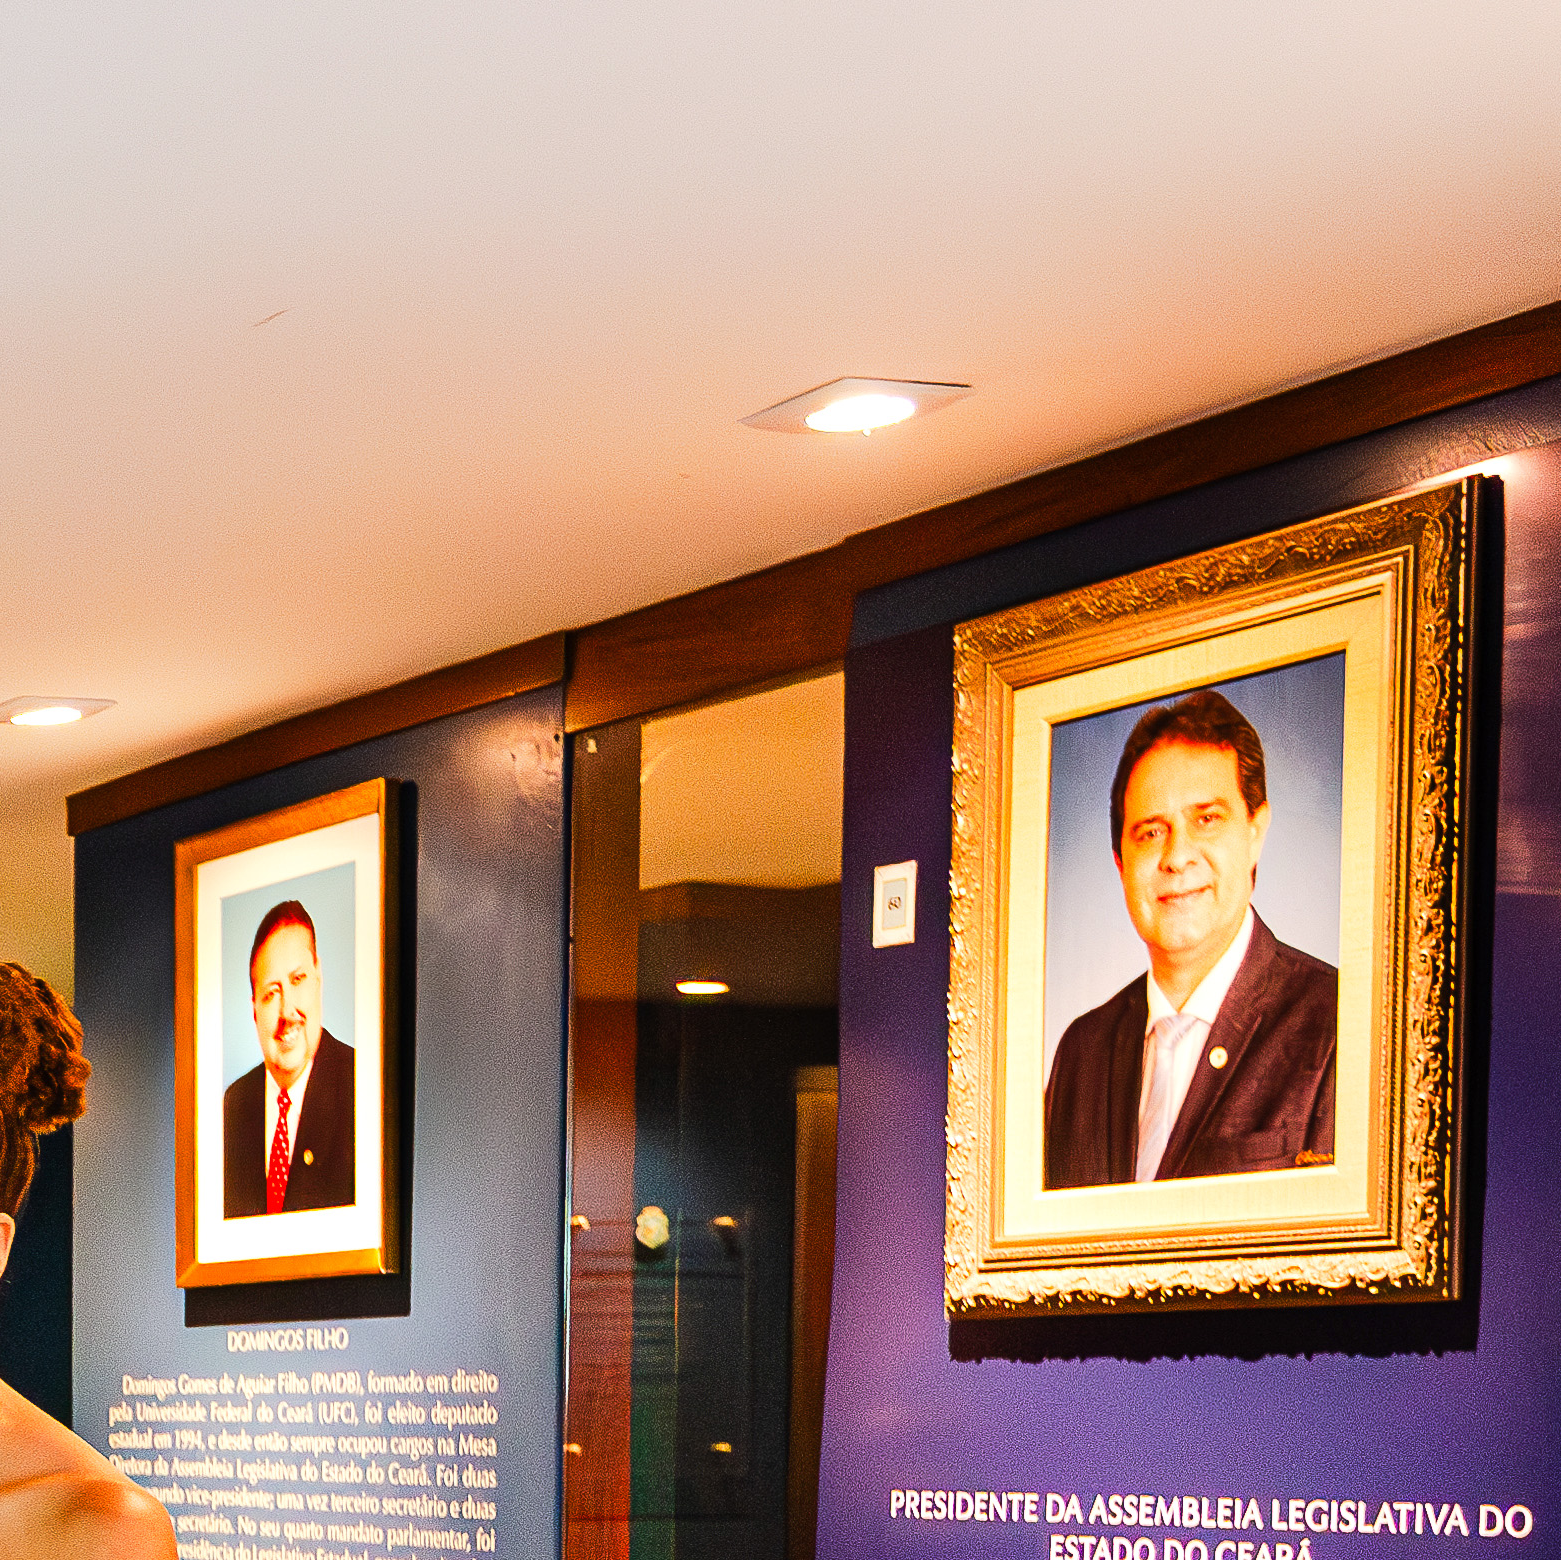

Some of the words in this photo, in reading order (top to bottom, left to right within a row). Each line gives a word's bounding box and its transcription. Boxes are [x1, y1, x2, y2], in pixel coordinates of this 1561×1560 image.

[228, 1329, 303, 1351] DOMINGOS
[306, 1327, 348, 1349] FILHO
[890, 1489, 1038, 1522] PRESIDENTE
[1045, 1492, 1083, 1523] DA
[1088, 1494, 1263, 1529] ASSEMBLEIA
[1271, 1499, 1468, 1536] LEGISLATIVA
[1479, 1506, 1532, 1537] DO
